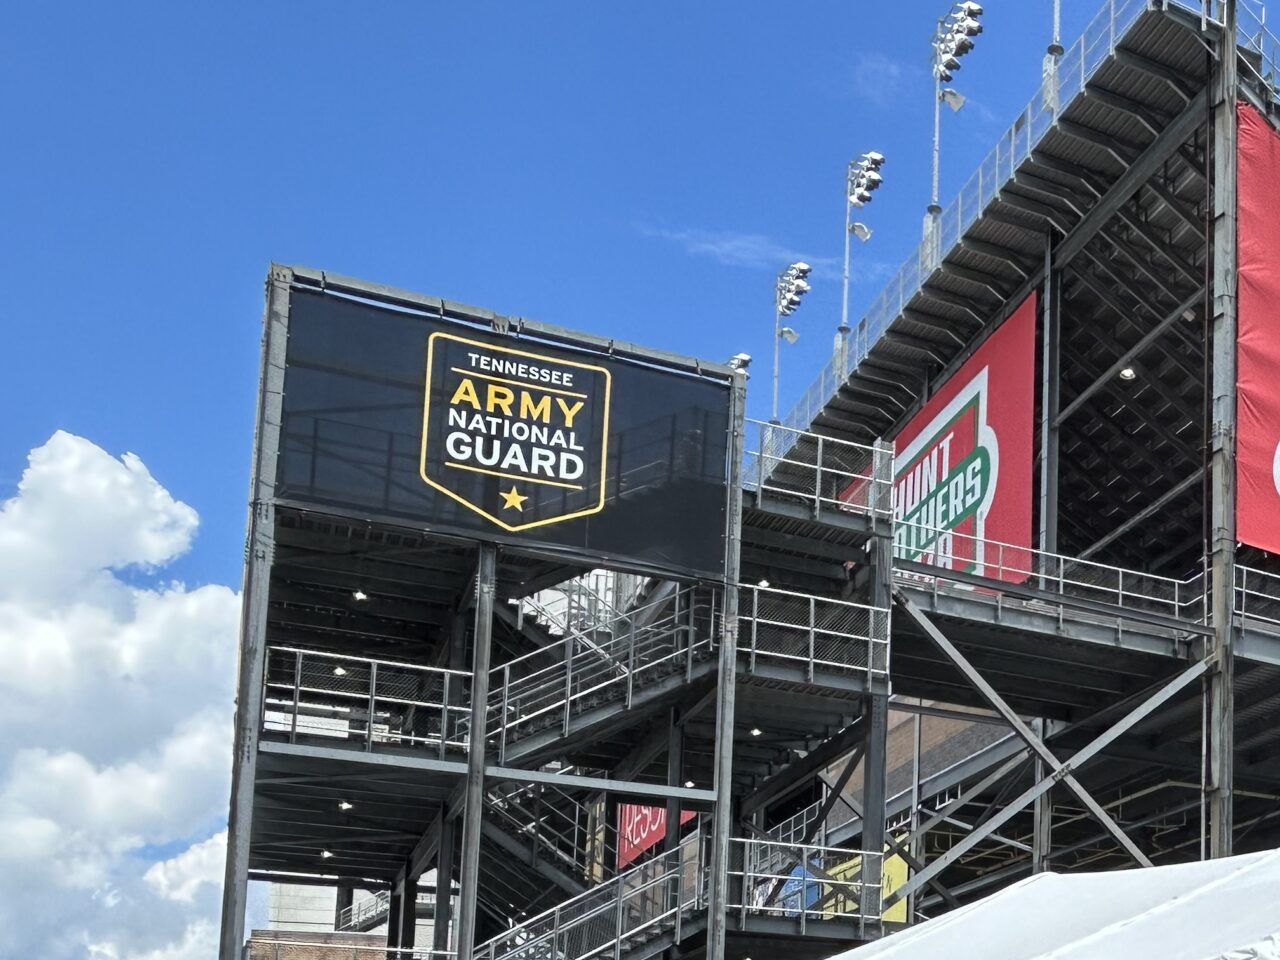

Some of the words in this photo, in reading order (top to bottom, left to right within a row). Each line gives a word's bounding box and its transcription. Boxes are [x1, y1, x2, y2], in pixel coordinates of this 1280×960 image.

[468, 352, 574, 387] TENNESSEE
[450, 378, 585, 428] ARMY
[448, 407, 585, 451] NATIONAL
[445, 431, 585, 480] GUARD
[894, 431, 954, 522] HUNT
